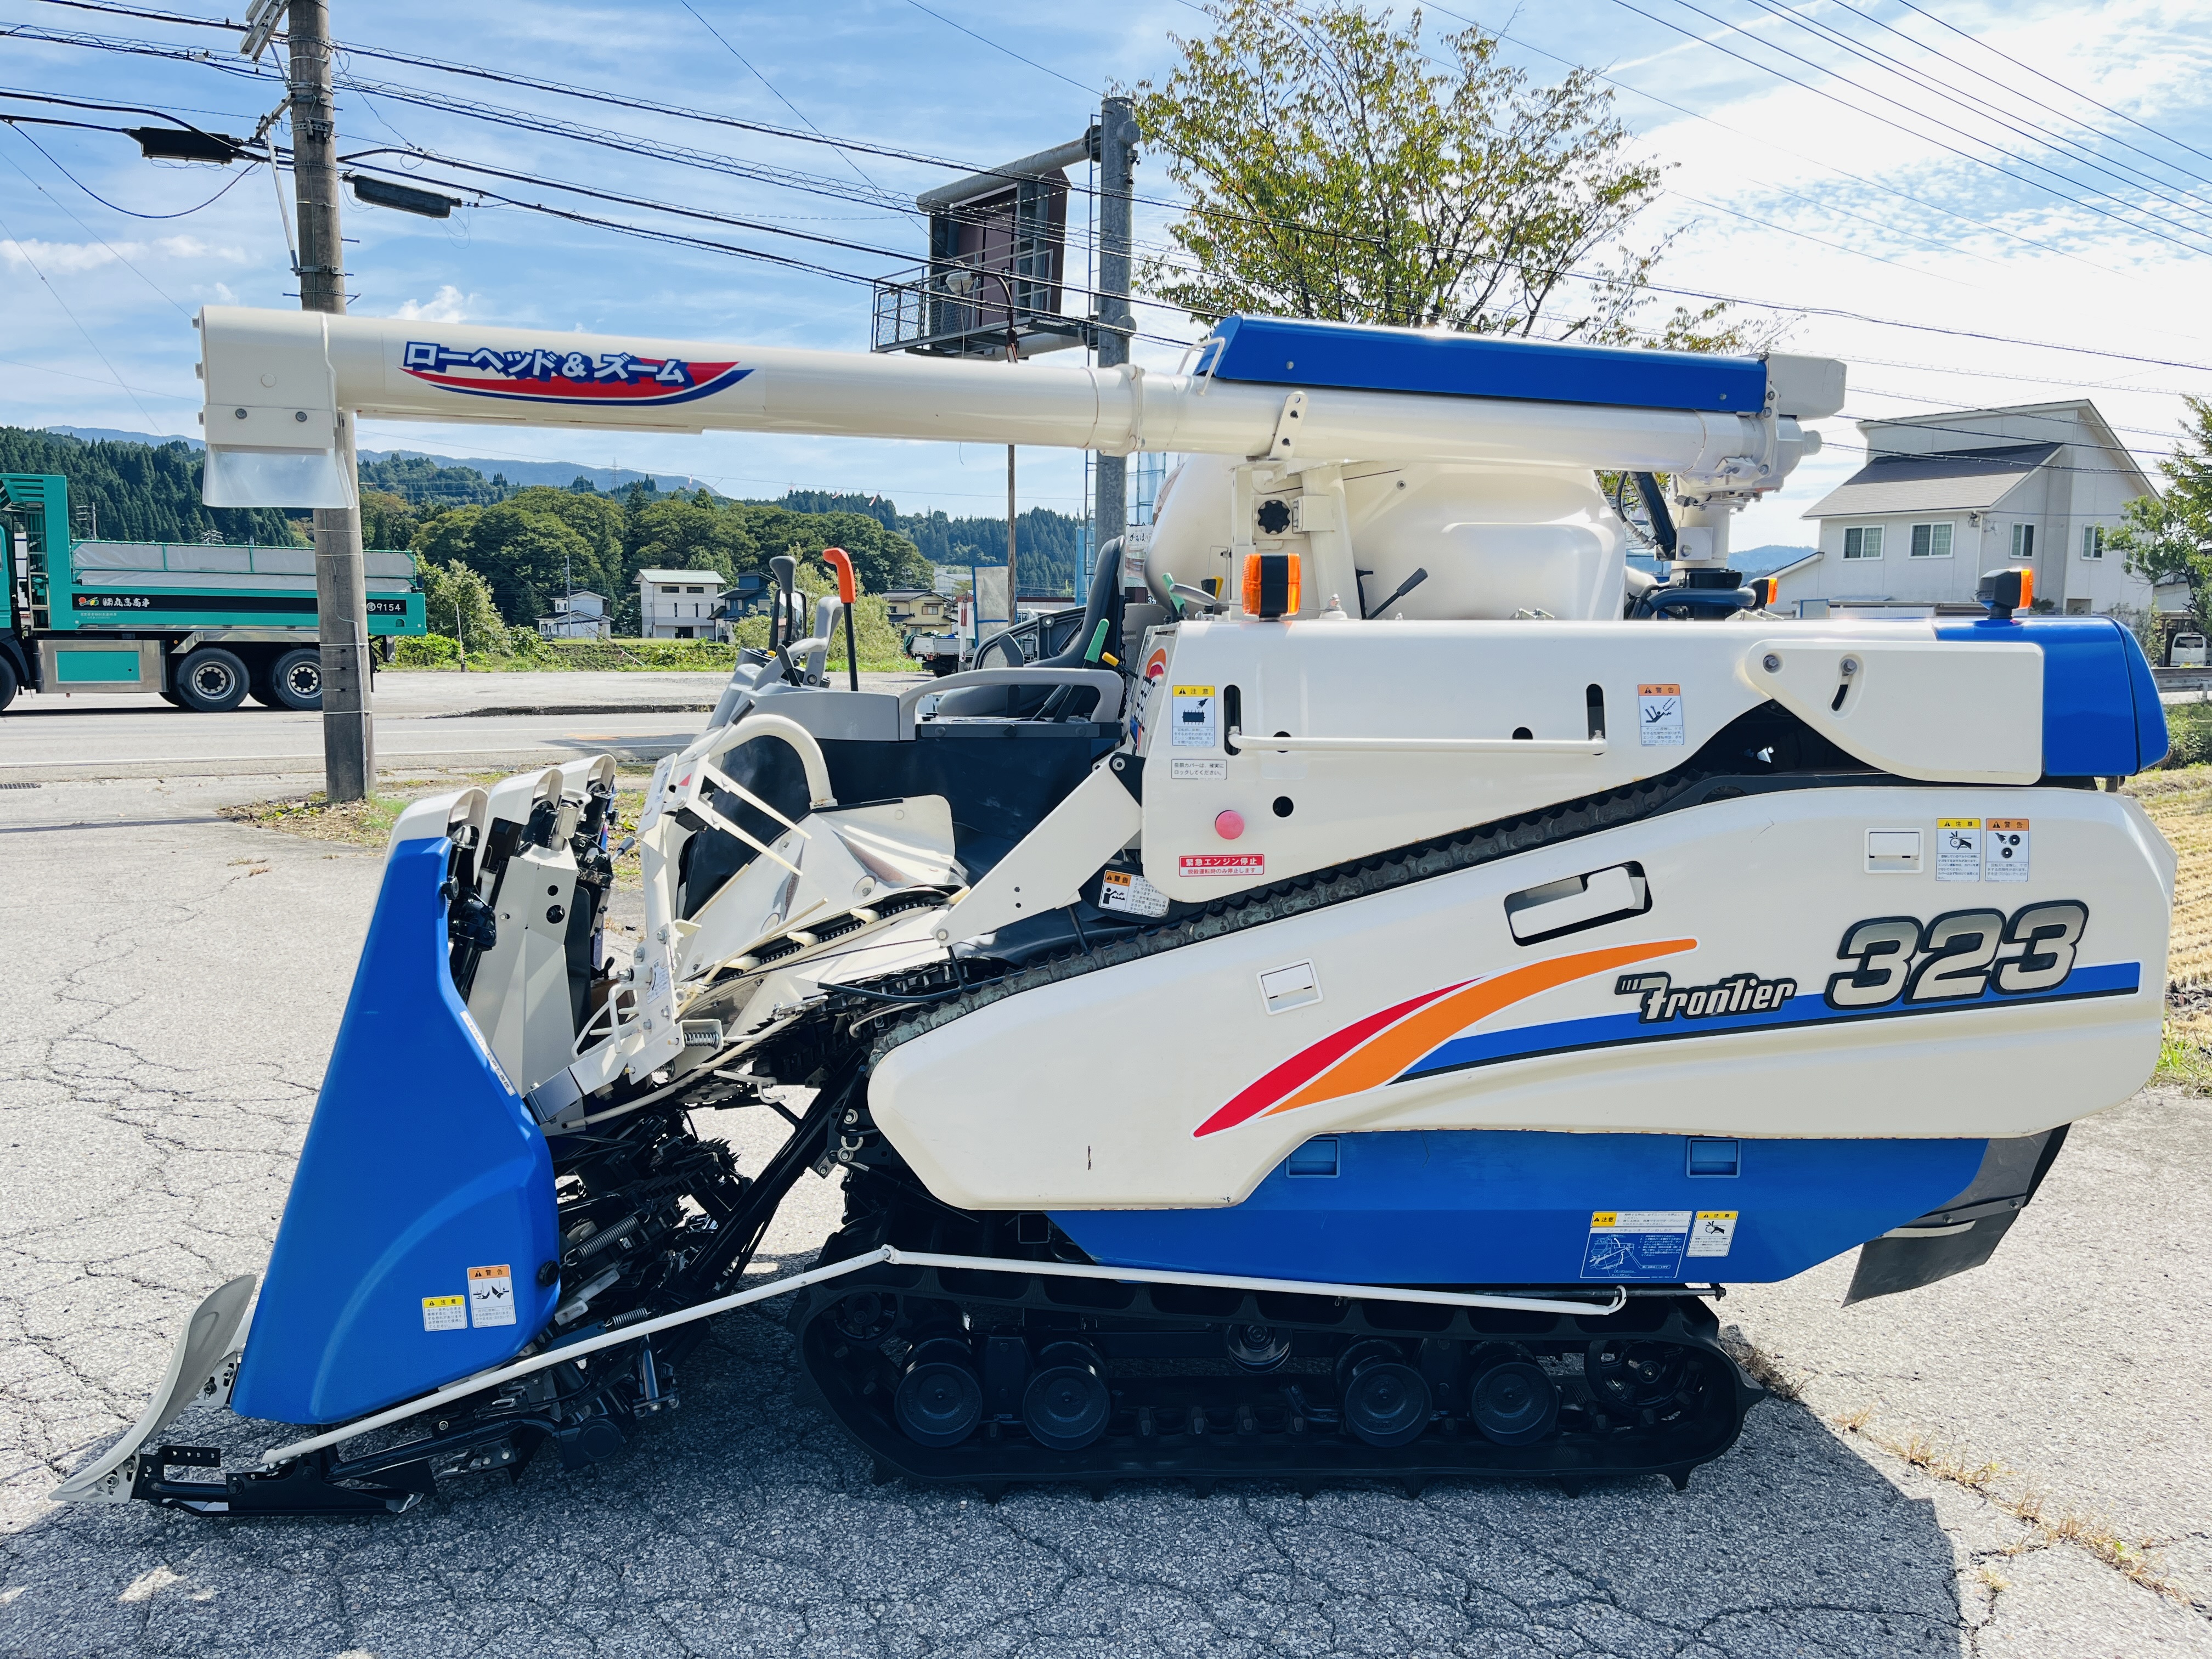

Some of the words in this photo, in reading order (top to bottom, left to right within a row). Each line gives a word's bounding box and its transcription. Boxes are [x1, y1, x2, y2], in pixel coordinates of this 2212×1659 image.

[405, 341, 687, 385] ローヘッド&ズーム
[1114, 875, 1128, 883] 警告
[1186, 857, 1257, 866] 緊急エンジン停止
[1826, 901, 2088, 1009] 323
[1622, 976, 1795, 1020] Frontier
